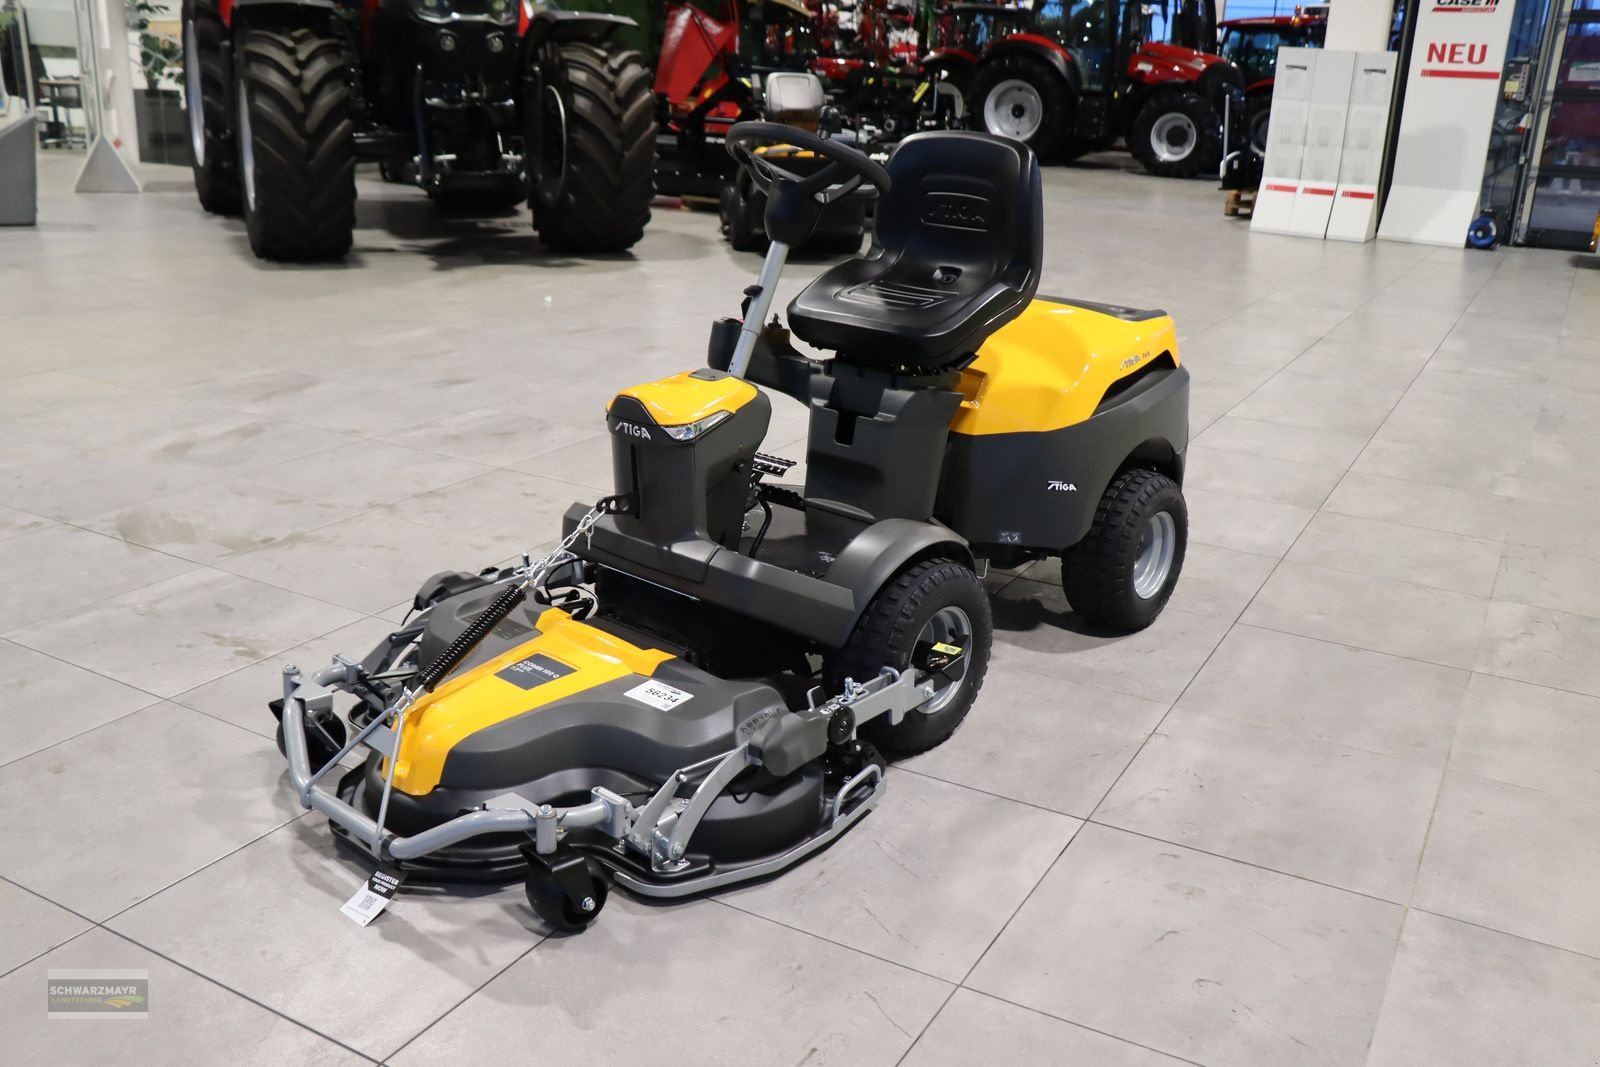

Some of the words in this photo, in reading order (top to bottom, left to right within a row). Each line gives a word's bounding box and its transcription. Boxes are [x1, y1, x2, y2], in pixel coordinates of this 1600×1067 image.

[1427, 43, 1488, 65] NEU
[615, 421, 652, 441] STIGA
[1047, 480, 1077, 491] STIGA
[645, 687, 679, 703] 56234
[374, 870, 399, 886] REGISTER
[373, 884, 388, 893] NOW
